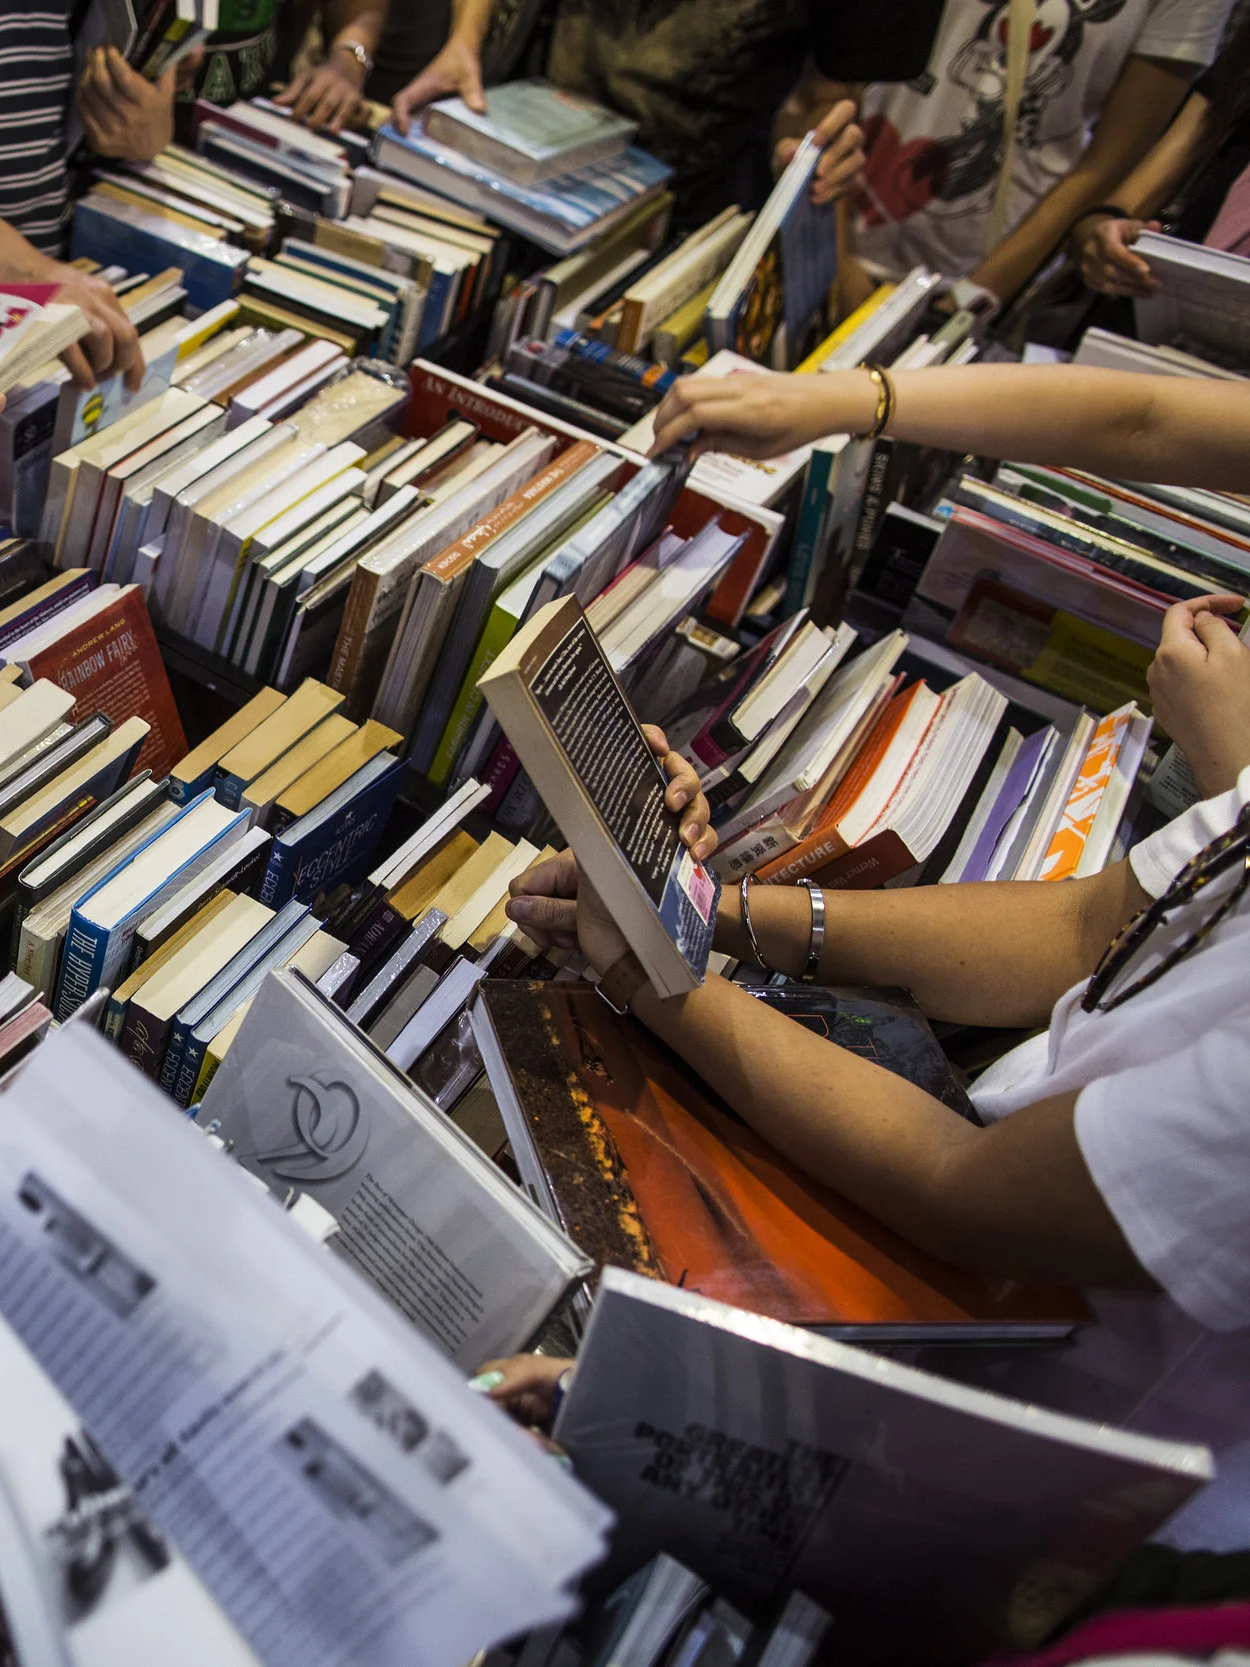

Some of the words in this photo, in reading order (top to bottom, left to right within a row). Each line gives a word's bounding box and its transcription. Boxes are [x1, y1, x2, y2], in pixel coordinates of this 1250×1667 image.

[72, 633, 104, 657] ANDREW
[105, 618, 125, 635] LANG
[343, 635, 353, 658] THE
[332, 658, 347, 689] MASTA
[297, 813, 378, 885] ECCENTRIC
[762, 840, 836, 885] ITECTURE
[71, 927, 98, 959] THE
